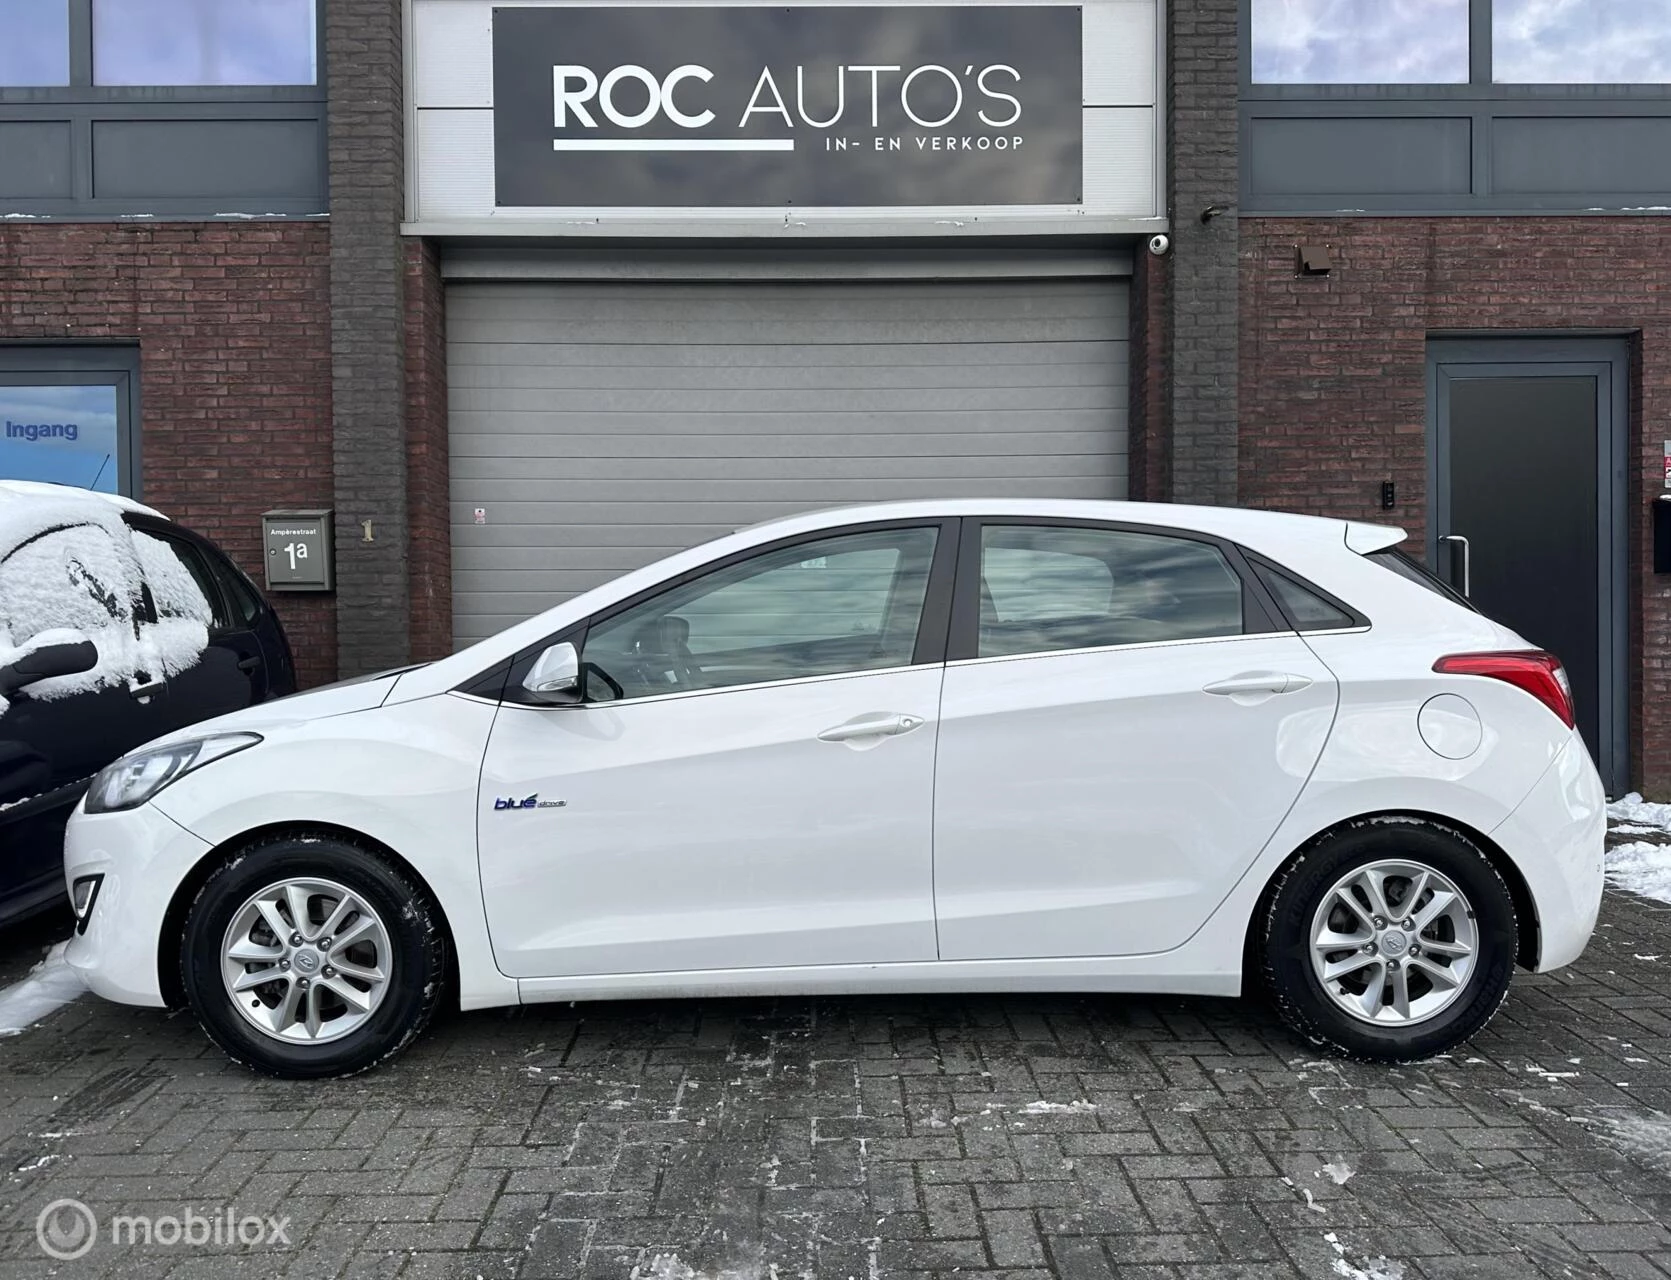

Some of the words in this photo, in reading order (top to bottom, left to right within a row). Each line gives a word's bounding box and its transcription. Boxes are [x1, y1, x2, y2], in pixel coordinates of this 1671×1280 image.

[553, 64, 716, 128] ROC
[738, 64, 1022, 128] AUTO'S
[826, 137, 860, 151] IN-
[874, 137, 901, 150] EN
[915, 136, 1023, 150] VERKOOP
[6, 421, 78, 441] Ingang
[361, 519, 374, 542] 1
[284, 542, 308, 570] 1a
[494, 793, 538, 810] blue
